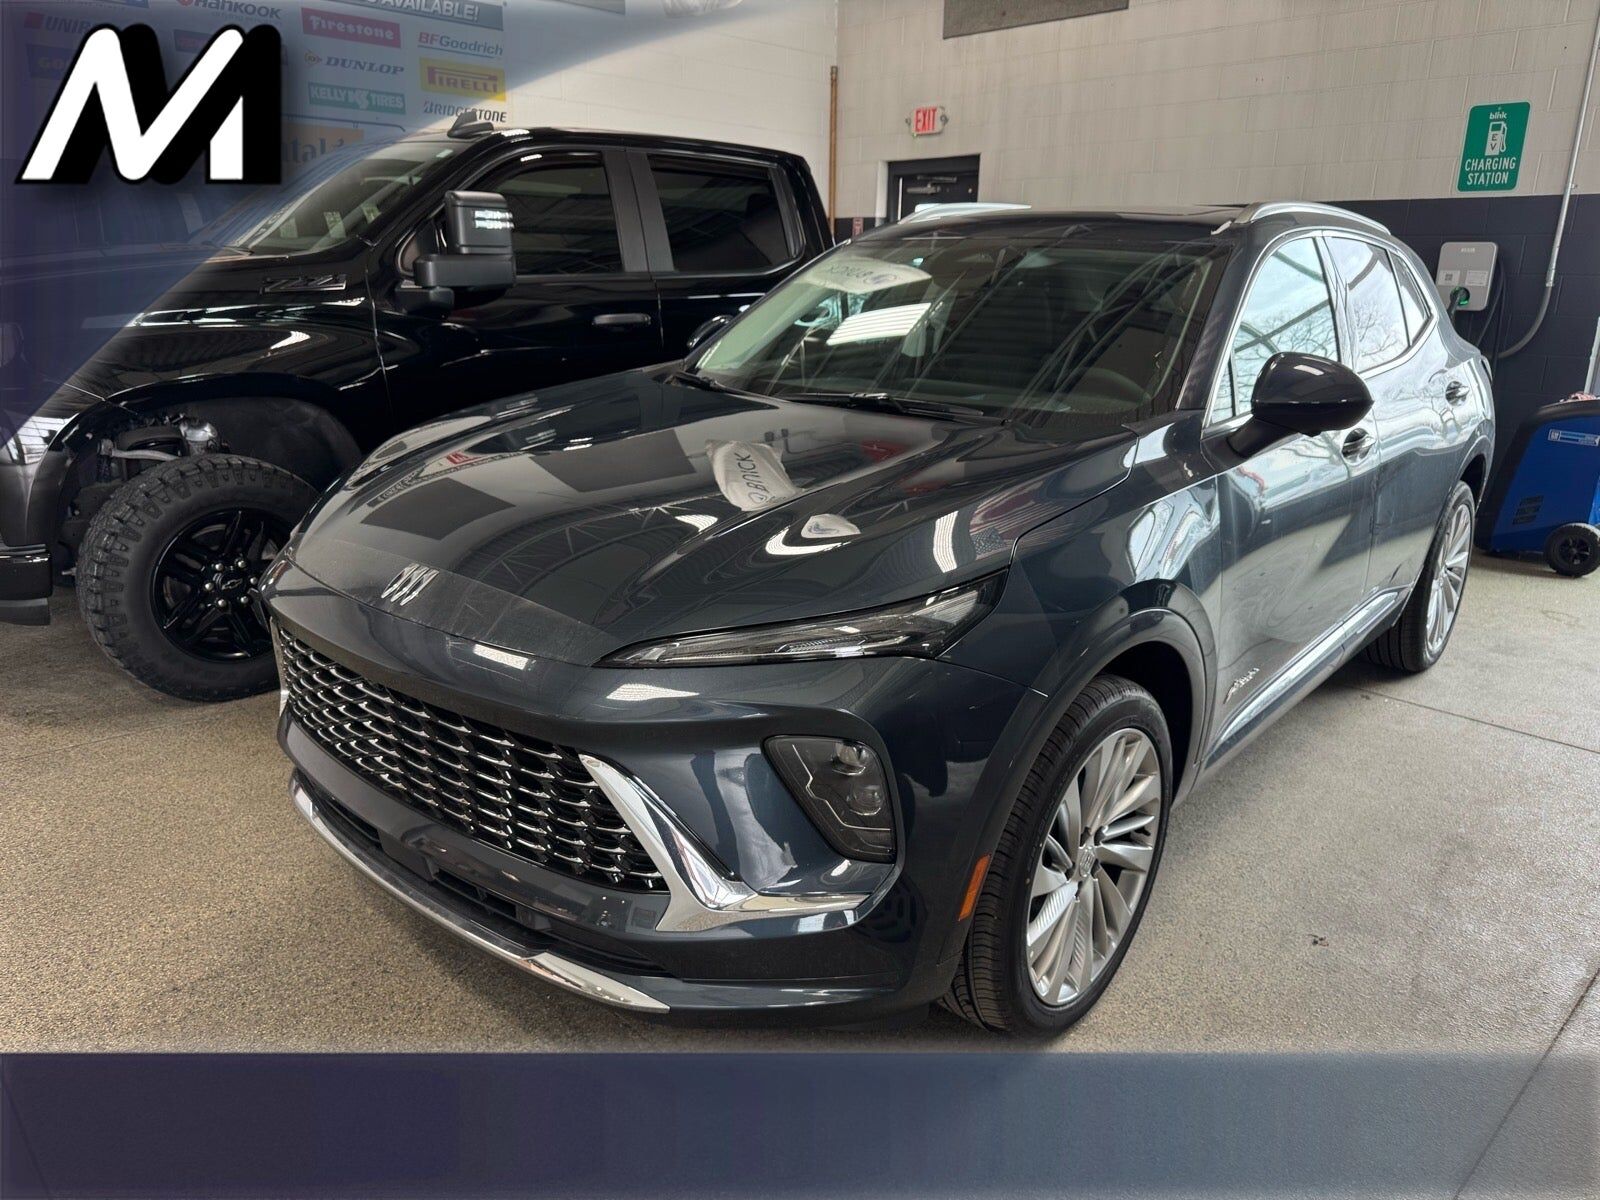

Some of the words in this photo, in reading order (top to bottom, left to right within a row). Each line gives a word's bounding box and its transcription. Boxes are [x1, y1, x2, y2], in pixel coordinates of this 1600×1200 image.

[310, 15, 394, 40] Firestone
[418, 31, 503, 56] BFGoodrich
[325, 56, 405, 75] DUNLOP
[427, 66, 498, 93] PIRELLI
[310, 85, 346, 102] KELLY
[370, 93, 404, 109] TIRES
[423, 100, 507, 123] BRIDGTONE
[914, 107, 938, 132] EXIT
[1489, 111, 1508, 120] blink
[1464, 157, 1517, 171] CHARGING
[1466, 172, 1509, 185] STATION
